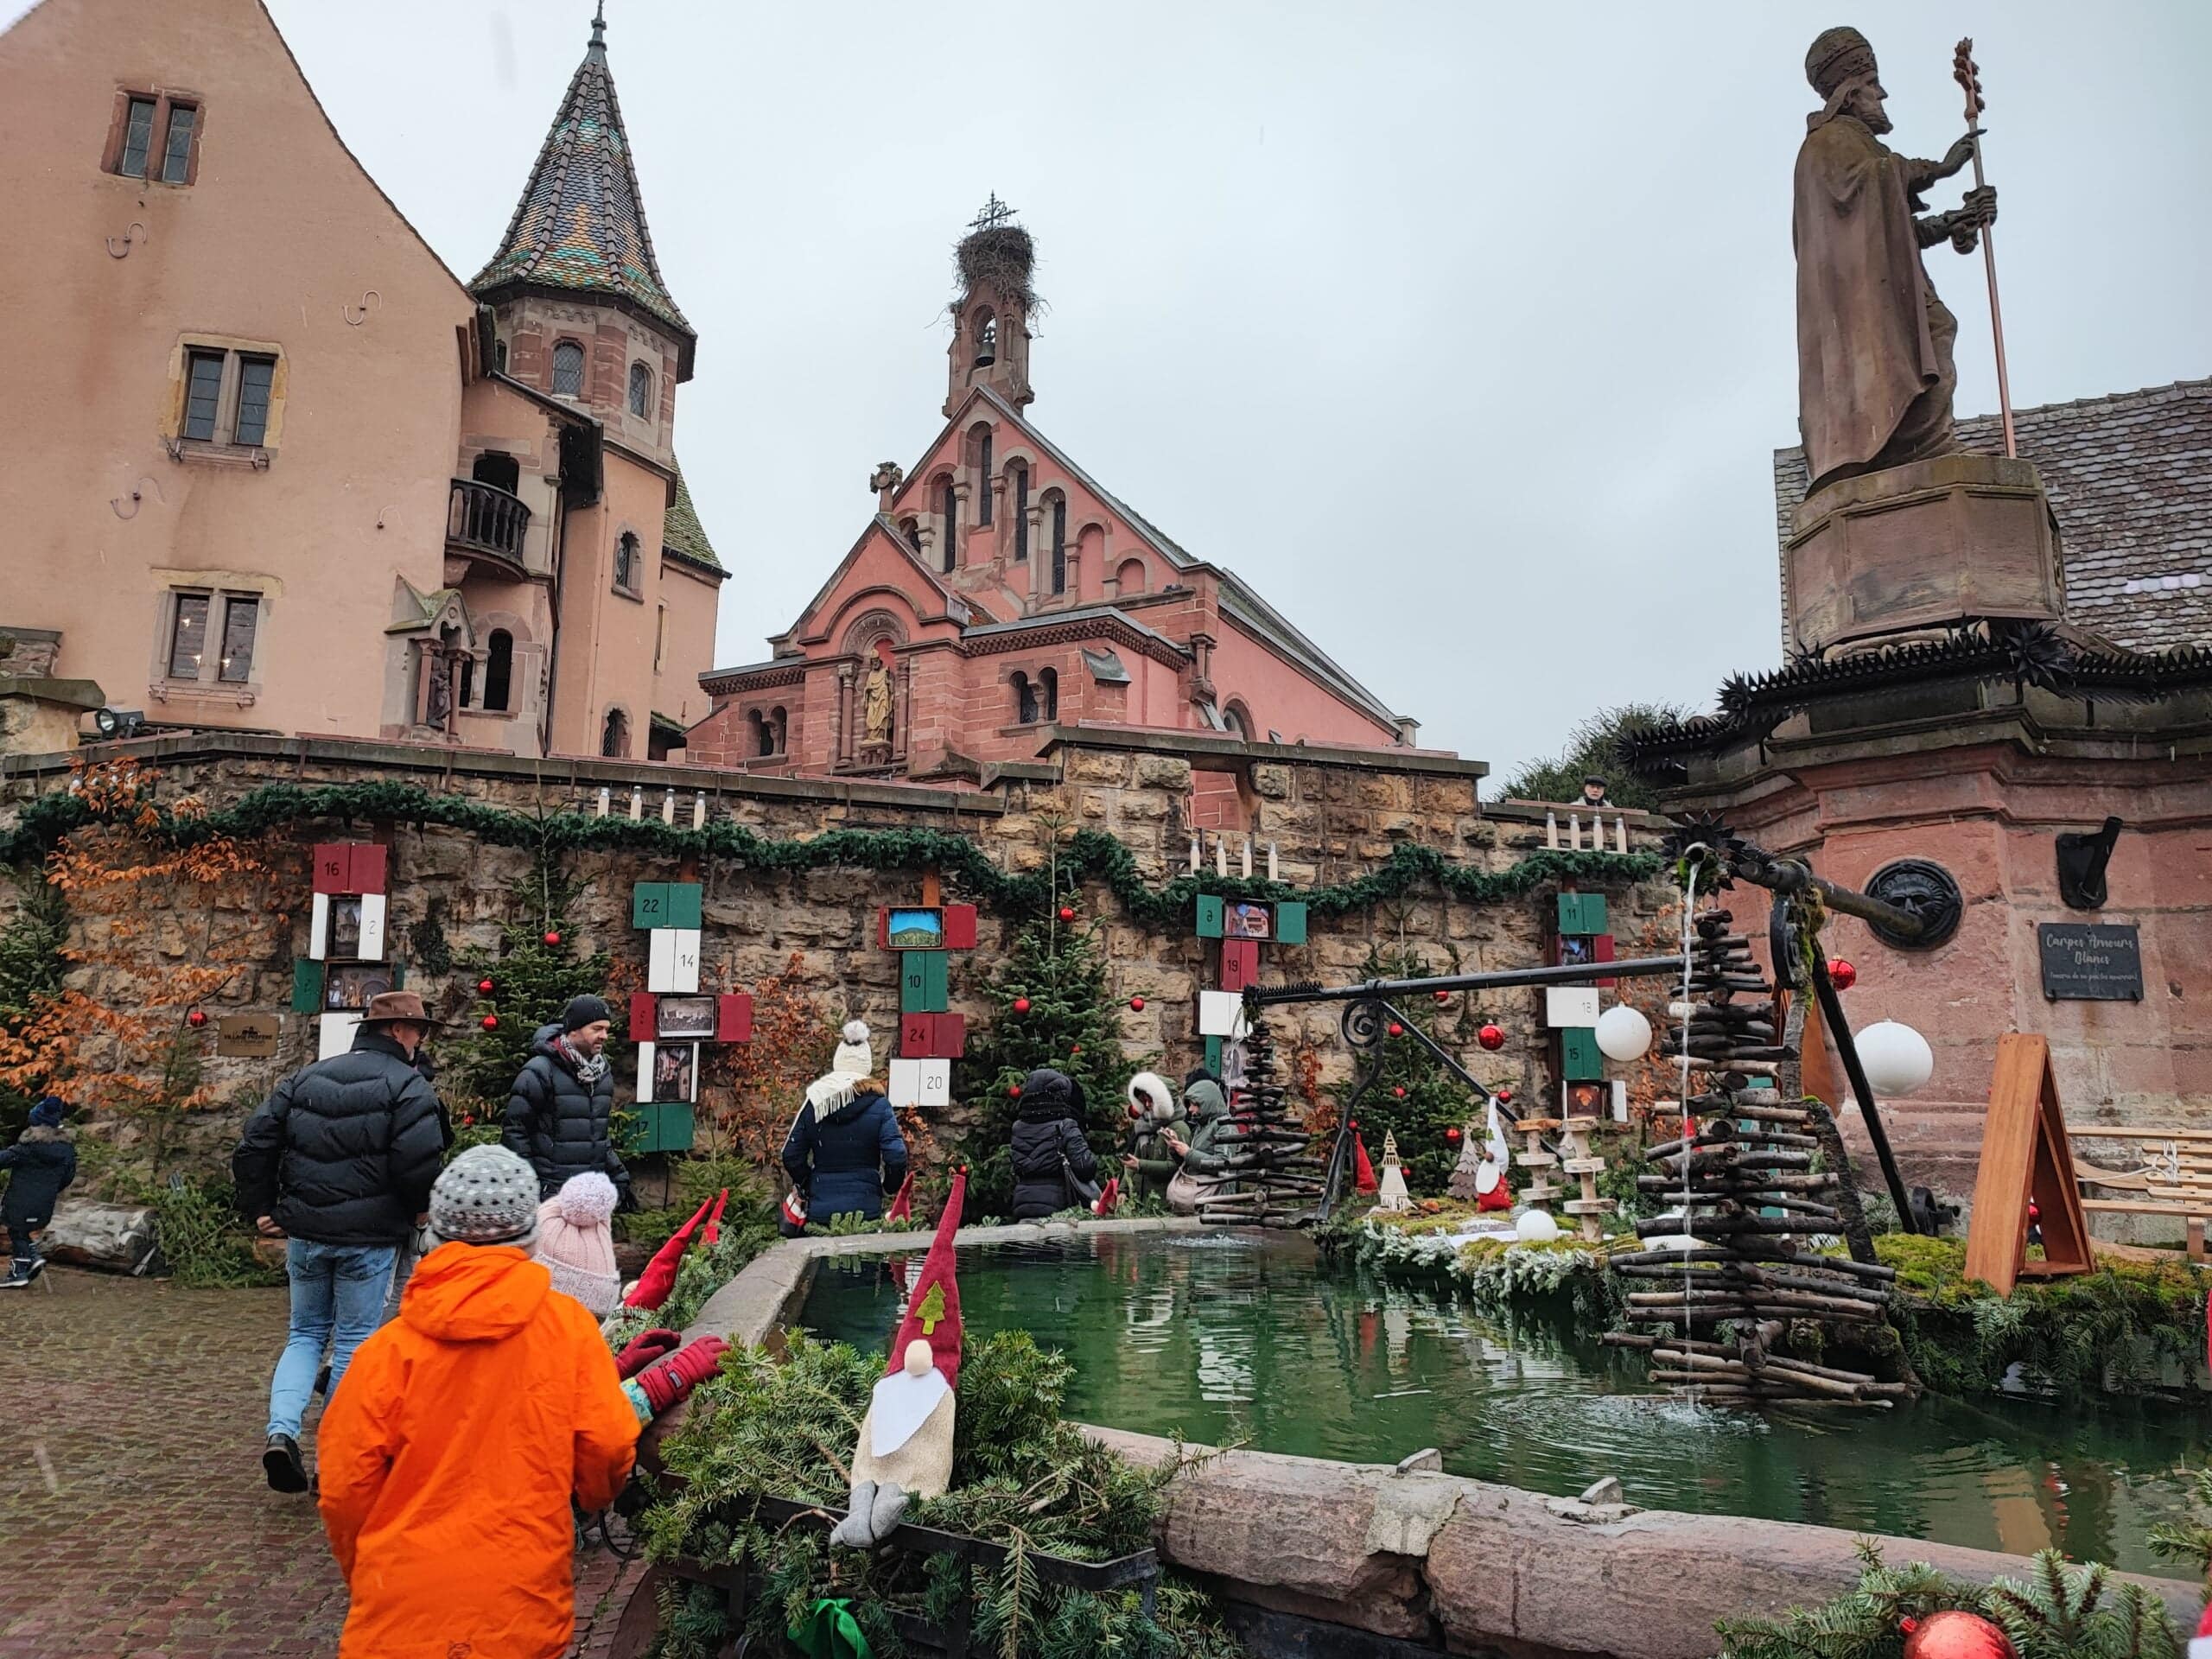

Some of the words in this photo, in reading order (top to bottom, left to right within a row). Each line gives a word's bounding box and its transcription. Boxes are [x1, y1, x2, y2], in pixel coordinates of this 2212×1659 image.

[325, 862, 340, 876] 16
[642, 899, 659, 913] 22
[1567, 908, 1577, 920] 11
[2046, 934, 2083, 950] Carpes
[2088, 934, 2134, 949] Amours
[680, 954, 695, 968] 14
[2075, 950, 2110, 965] Blancs
[1227, 960, 1238, 972] 19
[907, 975, 921, 988] 10
[910, 1028, 925, 1042] 24
[1568, 1047, 1580, 1060] 15
[926, 1076, 943, 1090] 20
[635, 1122, 648, 1135] 17
